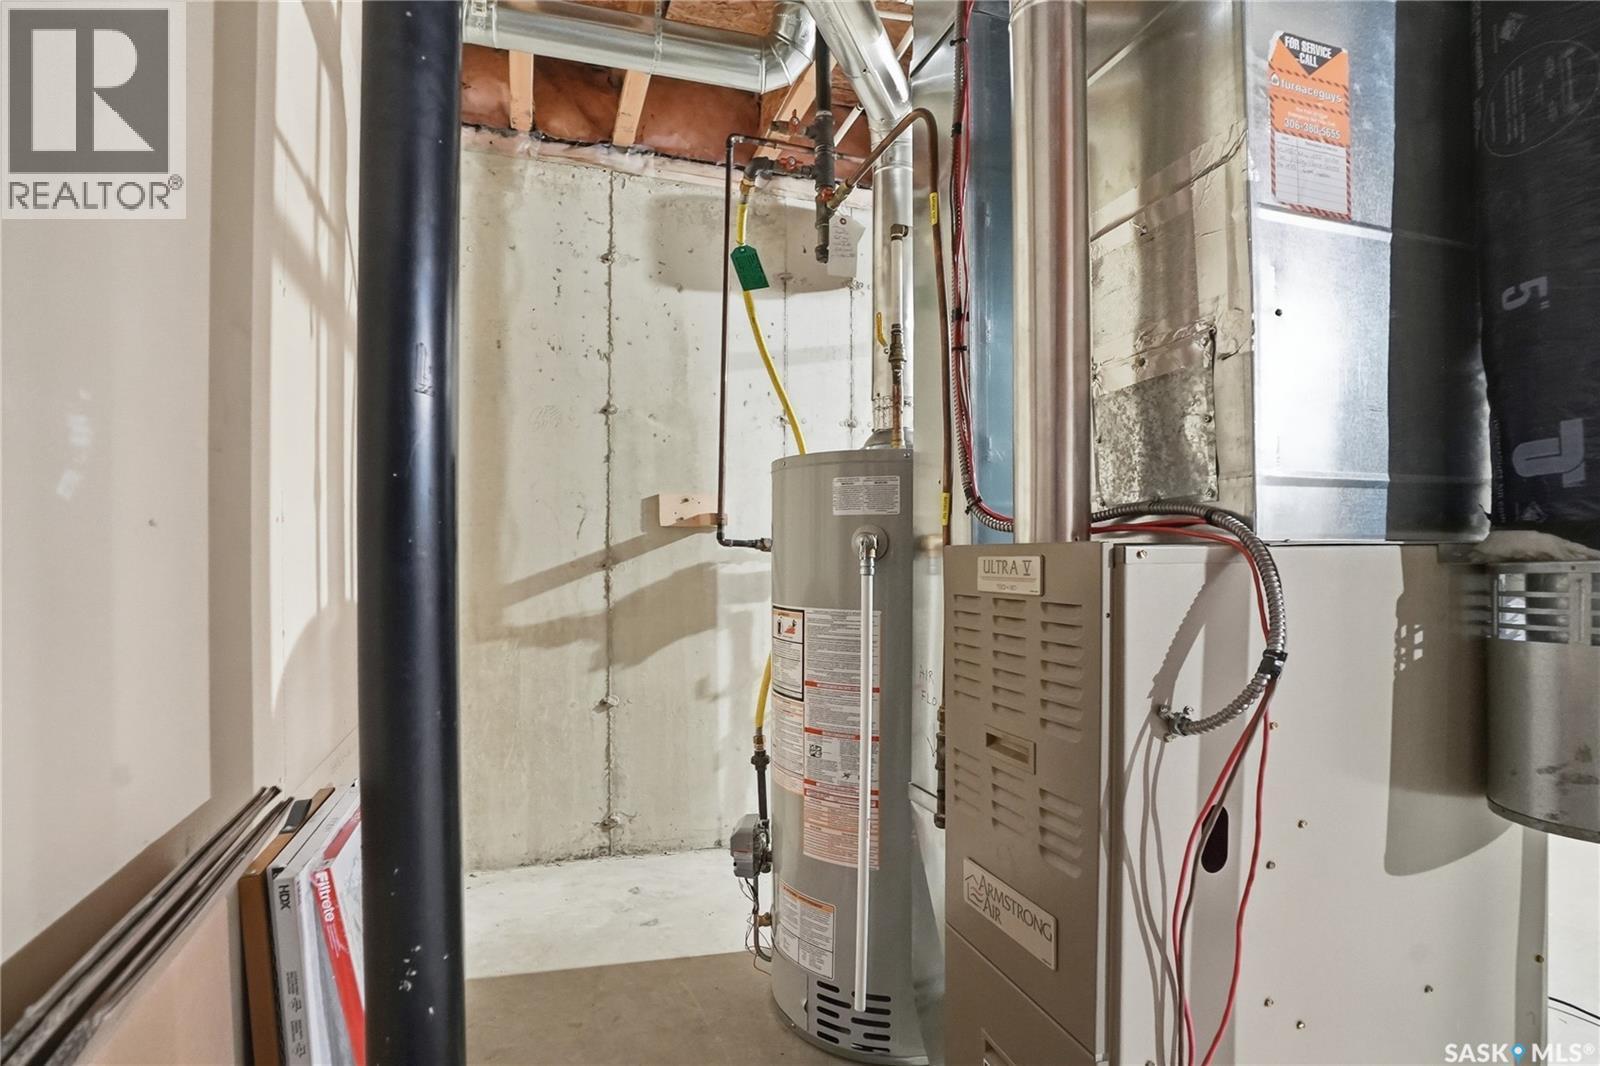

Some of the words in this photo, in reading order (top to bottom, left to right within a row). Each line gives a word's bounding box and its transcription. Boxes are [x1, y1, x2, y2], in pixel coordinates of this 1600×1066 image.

[1284, 35, 1300, 51] FOR
[1301, 40, 1333, 59] SERVICE
[1299, 52, 1318, 68] CALL
[1280, 79, 1343, 103] furnaceguys
[983, 559, 1019, 575] ULTRA
[1022, 559, 1033, 577] V
[278, 884, 291, 911] HDX
[978, 875, 1053, 942] ARMSTRONG
[982, 896, 1003, 925] AIR
